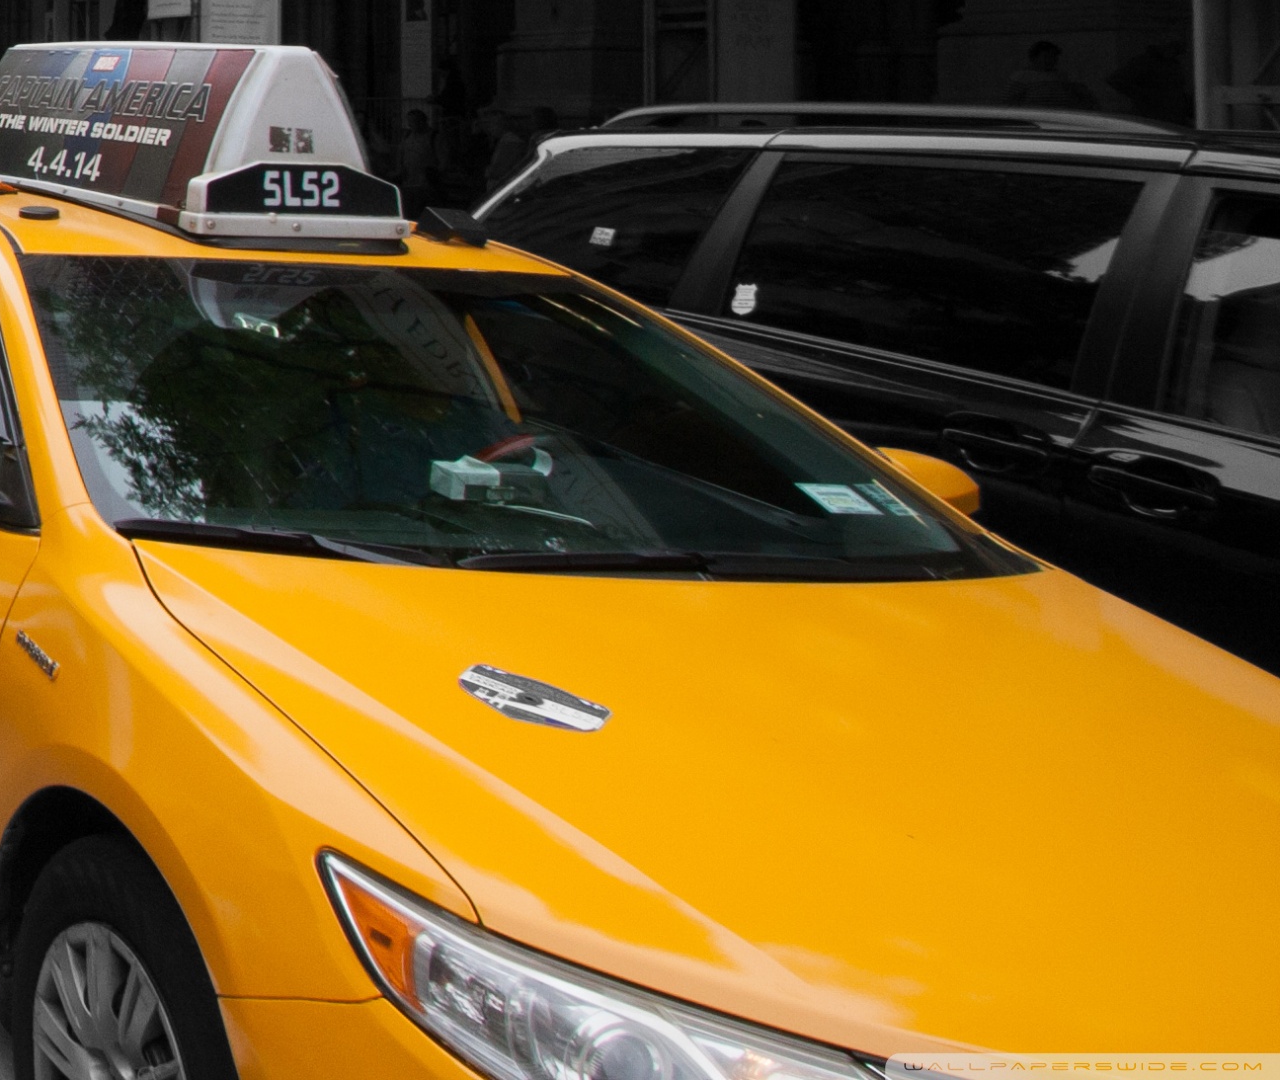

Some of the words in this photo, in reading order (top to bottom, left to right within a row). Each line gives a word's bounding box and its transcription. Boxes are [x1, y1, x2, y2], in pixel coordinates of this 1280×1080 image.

[83, 78, 212, 123] AMERICA
[0, 112, 26, 131] THE
[27, 116, 88, 139] WINTER
[89, 121, 172, 147] SOLDIER
[26, 146, 101, 182] 4.4.14
